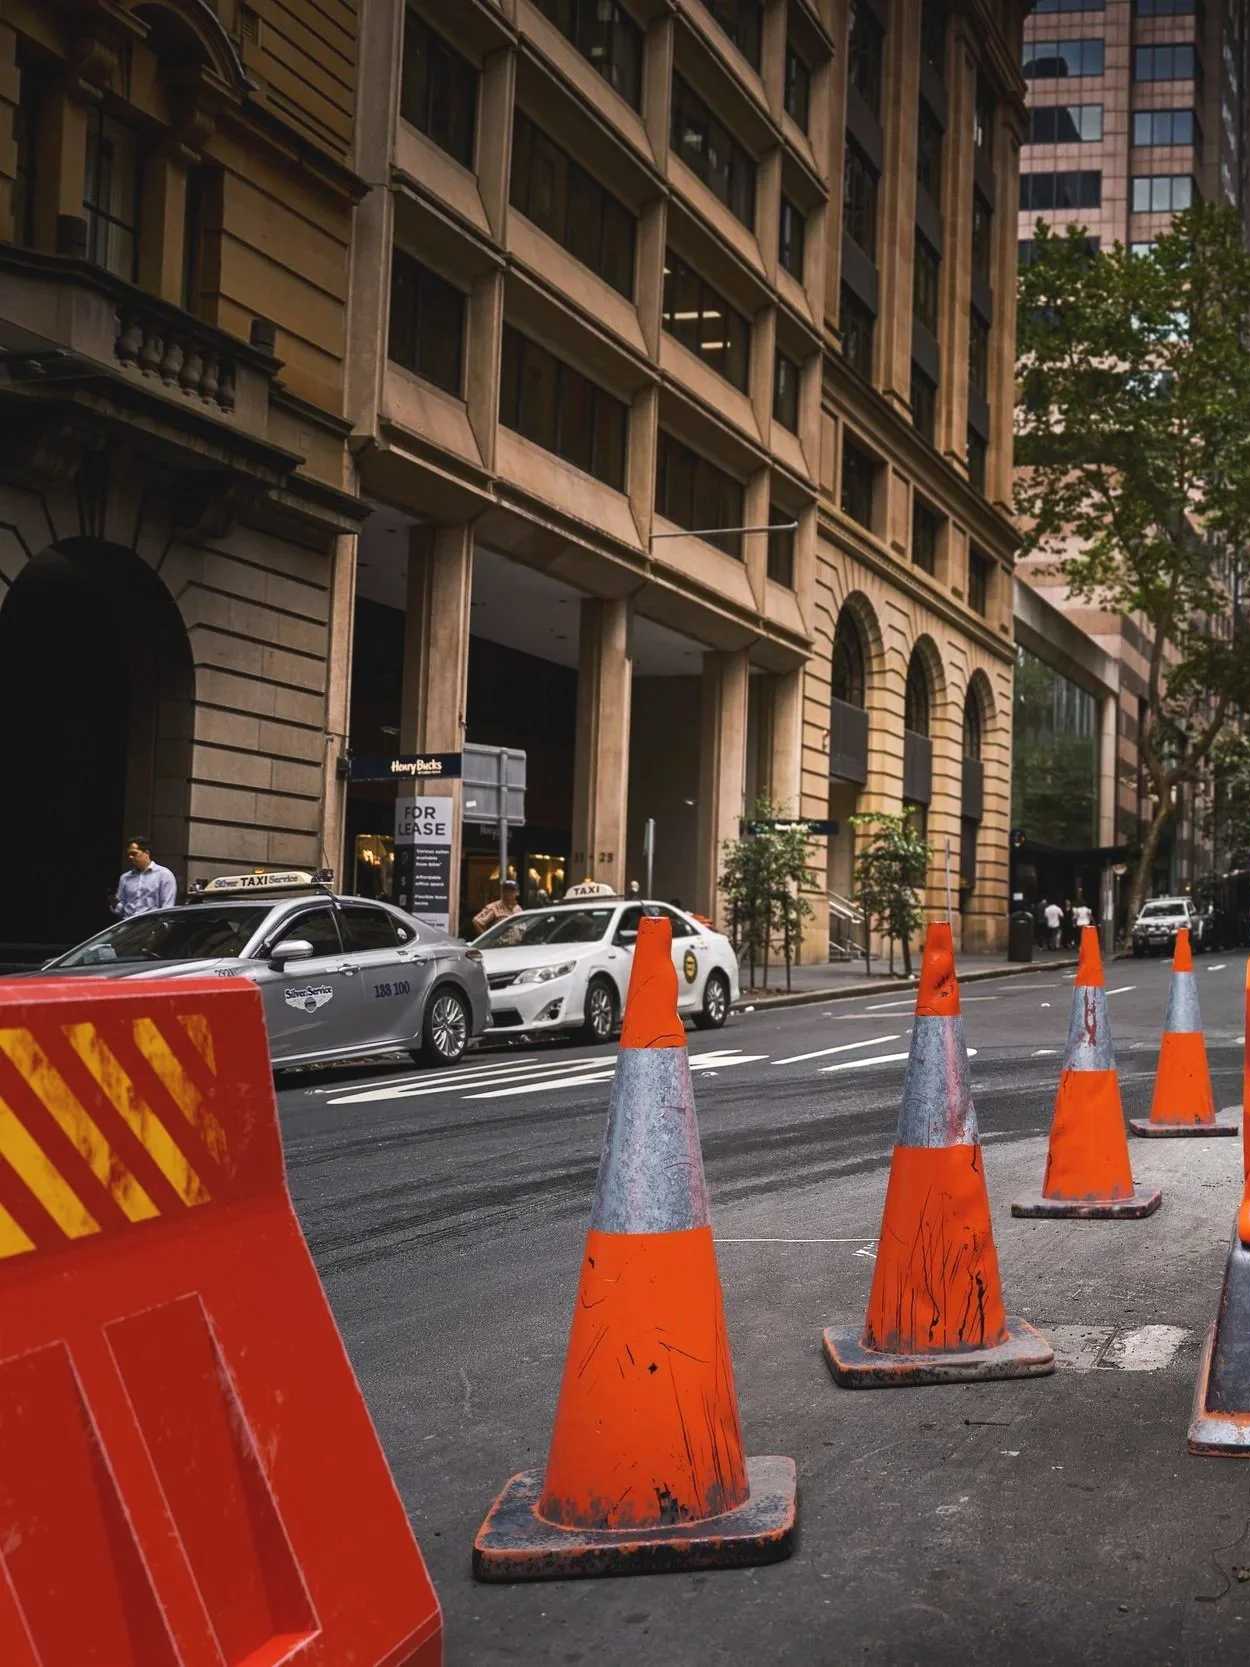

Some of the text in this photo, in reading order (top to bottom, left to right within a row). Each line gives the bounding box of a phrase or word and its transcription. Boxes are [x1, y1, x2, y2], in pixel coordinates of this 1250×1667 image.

[391, 758, 443, 776] Henry Bucks
[404, 806, 436, 820] FOR
[398, 822, 446, 836] LEASE
[214, 875, 299, 889] Silver TAXI Service
[574, 885, 600, 896] TAXI
[285, 986, 332, 1000] Silver Service
[392, 980, 410, 996] 100
